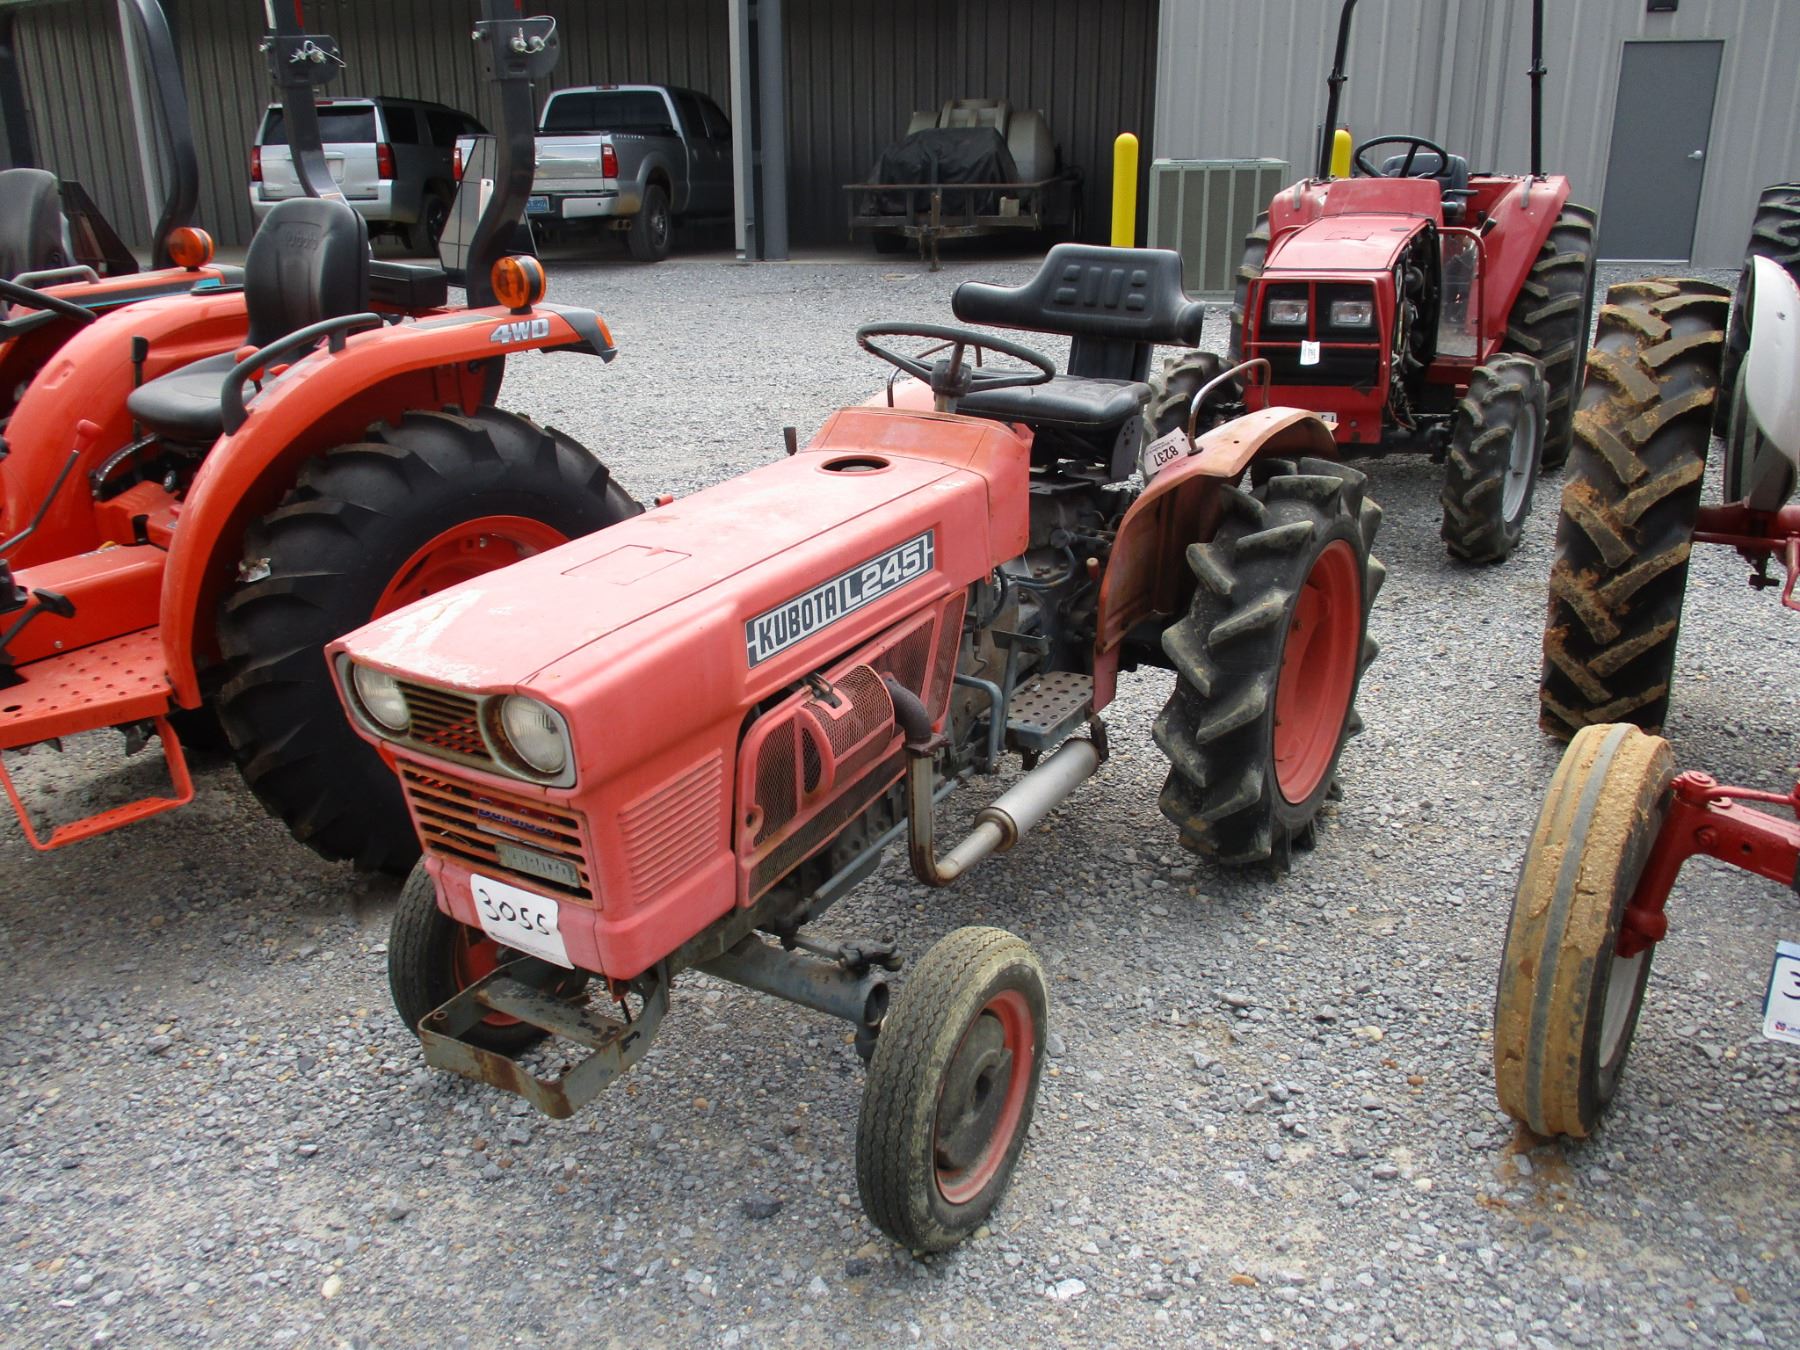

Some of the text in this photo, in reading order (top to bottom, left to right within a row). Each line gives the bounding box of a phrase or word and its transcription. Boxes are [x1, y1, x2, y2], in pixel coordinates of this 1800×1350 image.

[490, 318, 549, 344] 4WD
[1153, 445, 1179, 467] 8237
[758, 543, 921, 655] KUBOTA L245
[479, 888, 550, 936] 3055
